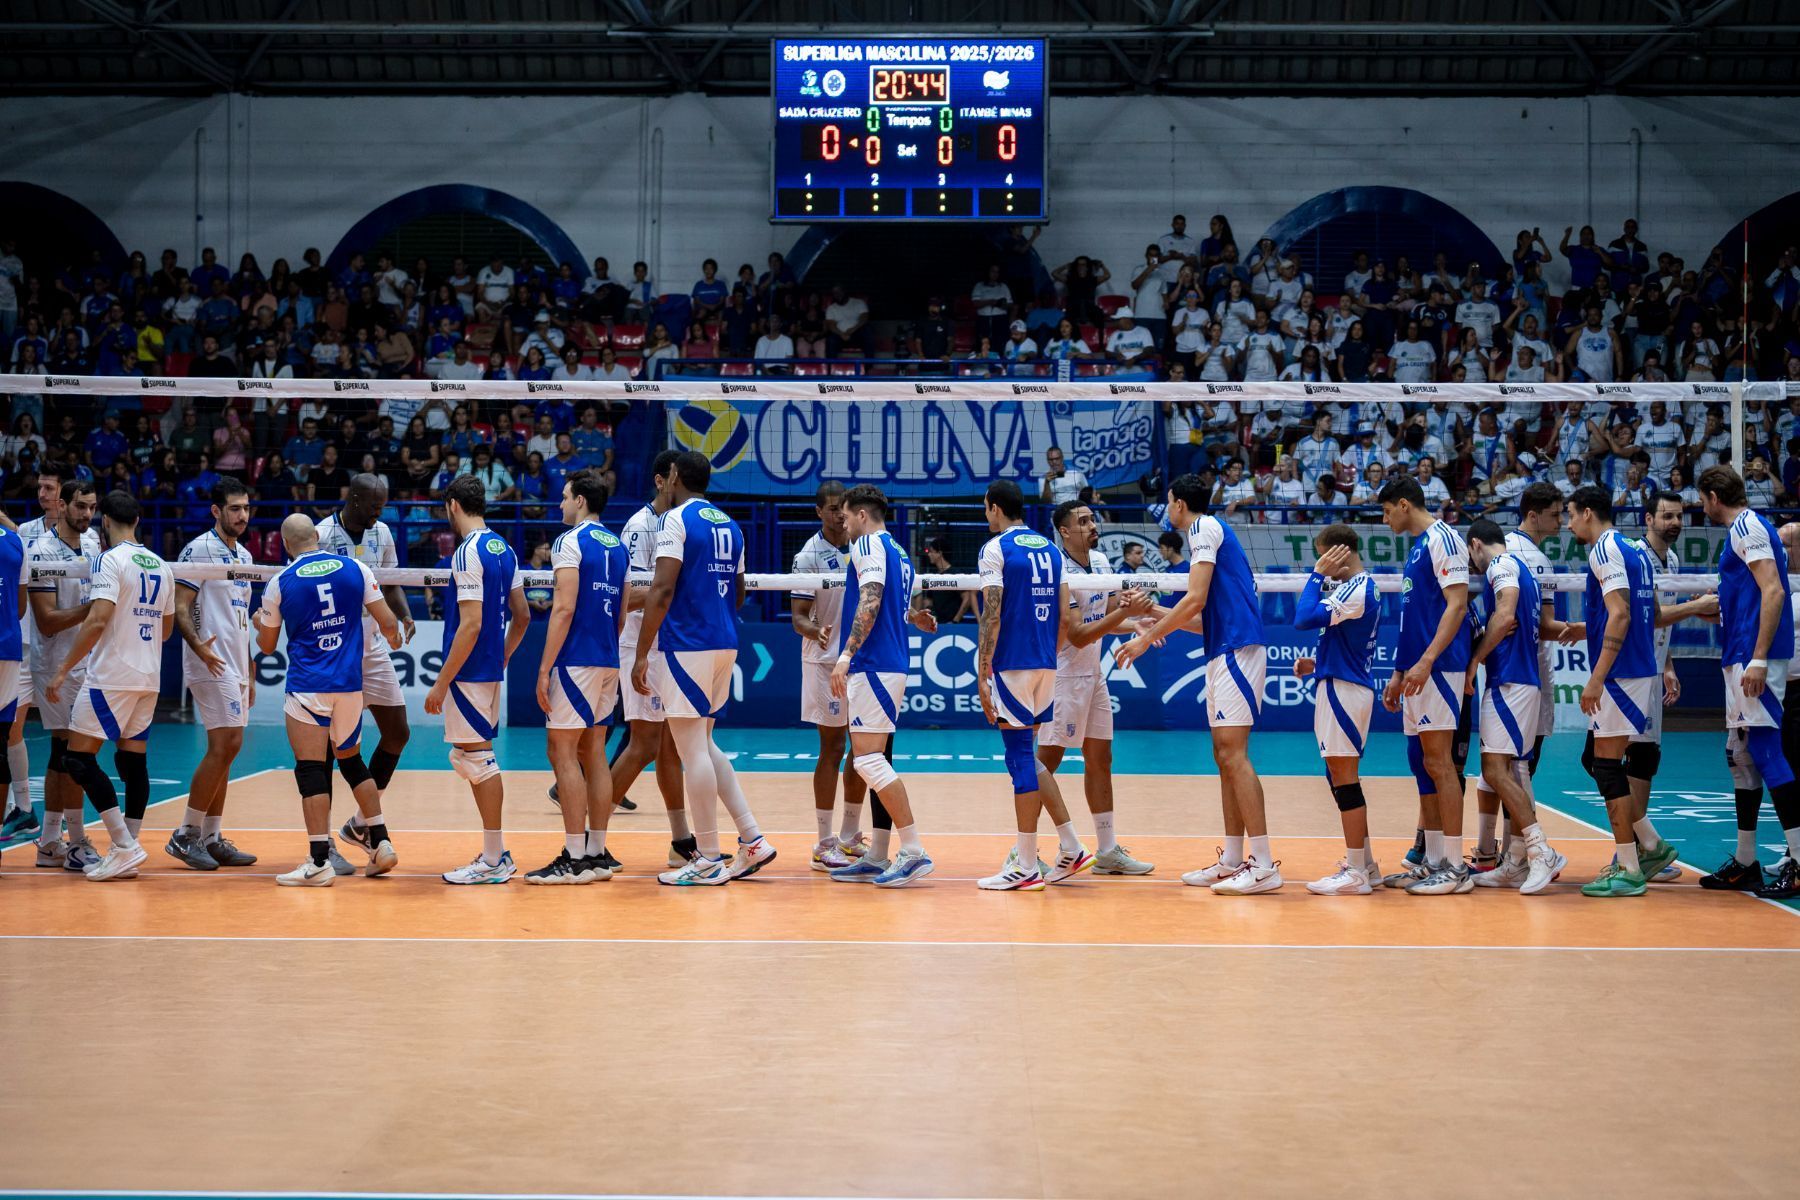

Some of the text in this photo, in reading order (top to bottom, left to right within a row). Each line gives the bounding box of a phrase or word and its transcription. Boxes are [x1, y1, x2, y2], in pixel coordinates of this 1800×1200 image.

[783, 45, 1035, 63] SUPERLIGA MASCULINA 2025/2026
[874, 70, 945, 99] 20:44
[779, 107, 862, 118] SADA CRUZEIRO
[1000, 107, 1032, 118] MINAS
[866, 106, 880, 132] 0
[886, 114, 931, 129] Tempos
[939, 106, 953, 132] 0
[822, 125, 840, 160] 0
[998, 125, 1017, 160] 0
[866, 135, 881, 165] 0
[897, 144, 917, 157] Set
[938, 135, 953, 165] 0
[804, 173, 1014, 185] 1 2 3 4
[53, 378, 80, 387] SUPERLIGA
[149, 379, 177, 388] SUPERLIGA
[246, 381, 274, 390] SUPERLIGA
[342, 382, 370, 391] SUPERLIGA
[438, 383, 467, 392] SUPERLIGA
[535, 384, 563, 392] SUPERLIGA
[632, 384, 661, 393] SUPERLIGA
[729, 384, 758, 393] SUPERLIGA
[826, 385, 855, 394] SUPERLIGA
[923, 385, 952, 394] SUPERLIGA
[1020, 385, 1049, 394] SUPERLIGA
[1118, 385, 1147, 394] SUPERLIGA
[1215, 385, 1244, 394] SUPERLIGA
[1312, 385, 1341, 394] SUPERLIGA
[1410, 386, 1438, 395] SUPERLIGA
[1507, 386, 1535, 395] SUPERLIGA
[1604, 386, 1632, 395] SUPERLIGA
[1701, 386, 1731, 395] SUPERLIGA
[1073, 417, 1149, 453] tamara
[1074, 441, 1152, 478] sports
[711, 527, 733, 560] 10
[133, 554, 161, 567] SADA
[39, 569, 67, 577] SUPERLIGA
[303, 561, 337, 576] SADA
[1027, 551, 1054, 584] 14
[234, 573, 262, 581] SUPERLIGA
[139, 572, 162, 605] 17
[630, 580, 652, 588] SUPERLI
[929, 578, 958, 588] SUPERLIGA
[1129, 580, 1158, 588] SUPERLIGA
[316, 582, 337, 617] 5
[237, 609, 249, 632] 14
[312, 615, 346, 631] MATHEUS
[322, 636, 339, 648] BH
